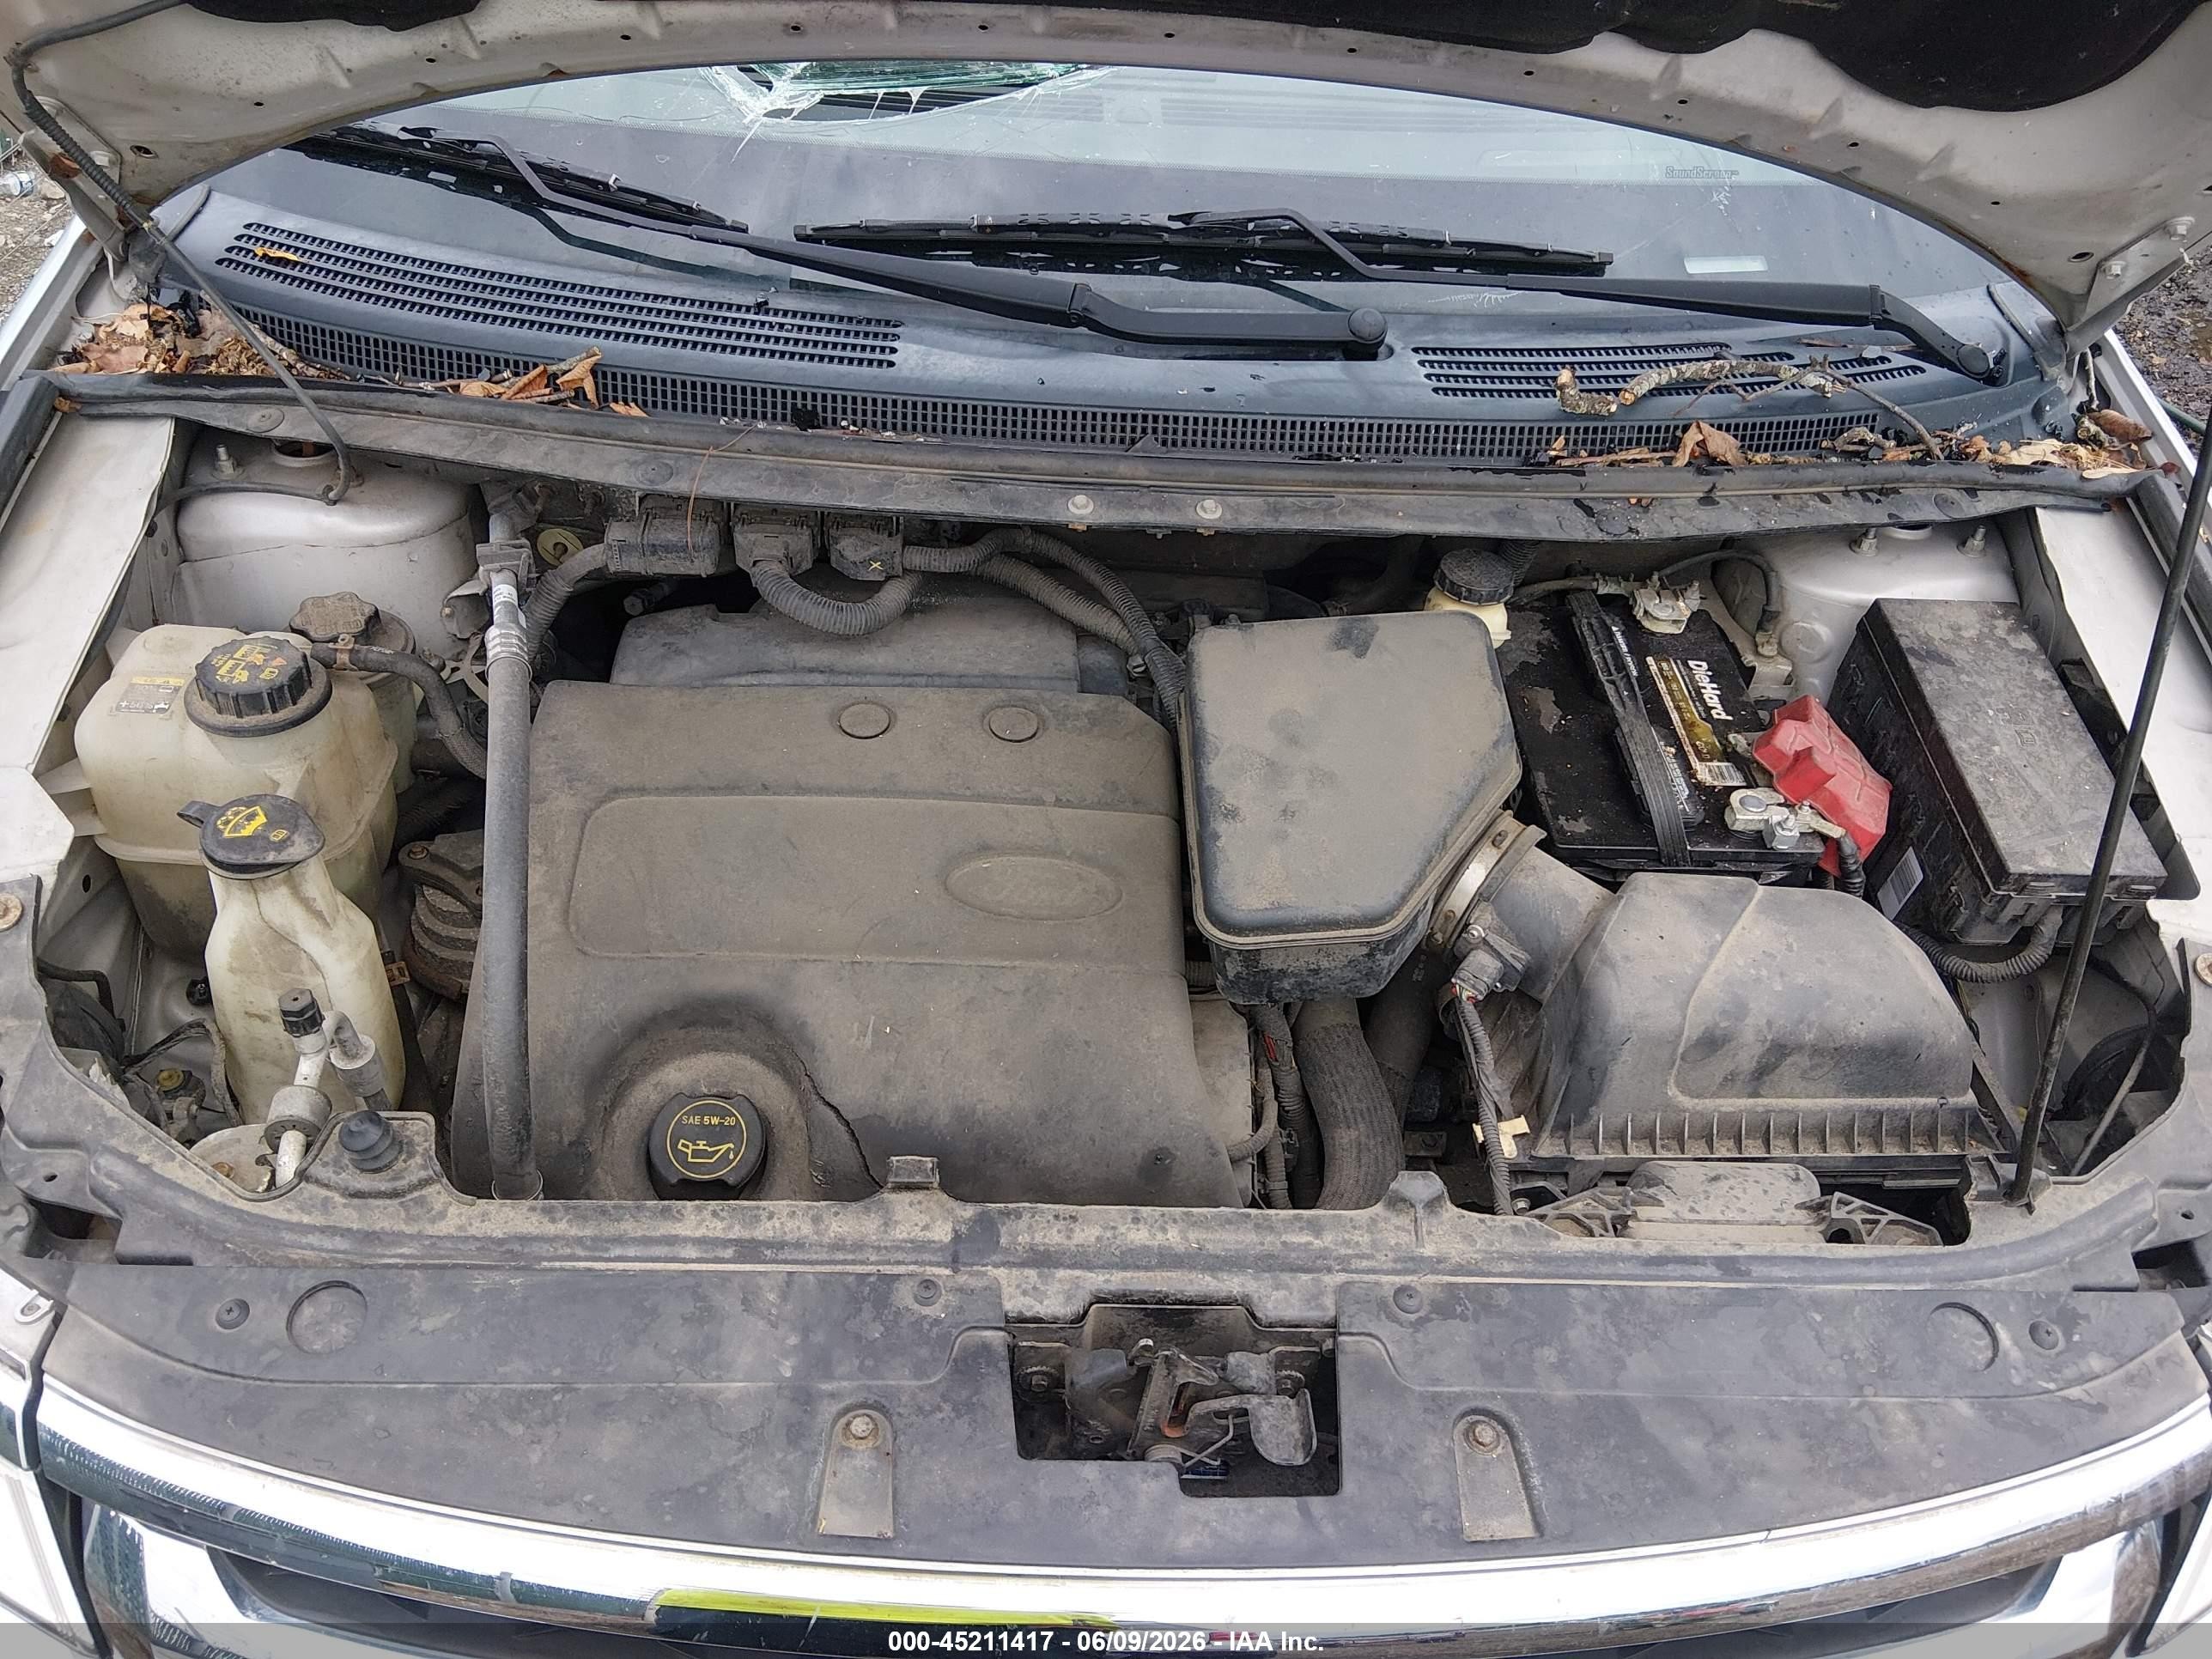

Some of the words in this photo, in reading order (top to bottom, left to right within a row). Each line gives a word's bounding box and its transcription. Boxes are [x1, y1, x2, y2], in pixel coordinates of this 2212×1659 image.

[1686, 659, 1734, 720] DieHard
[681, 1115, 701, 1125] SAE
[703, 1115, 736, 1126] 5W-20
